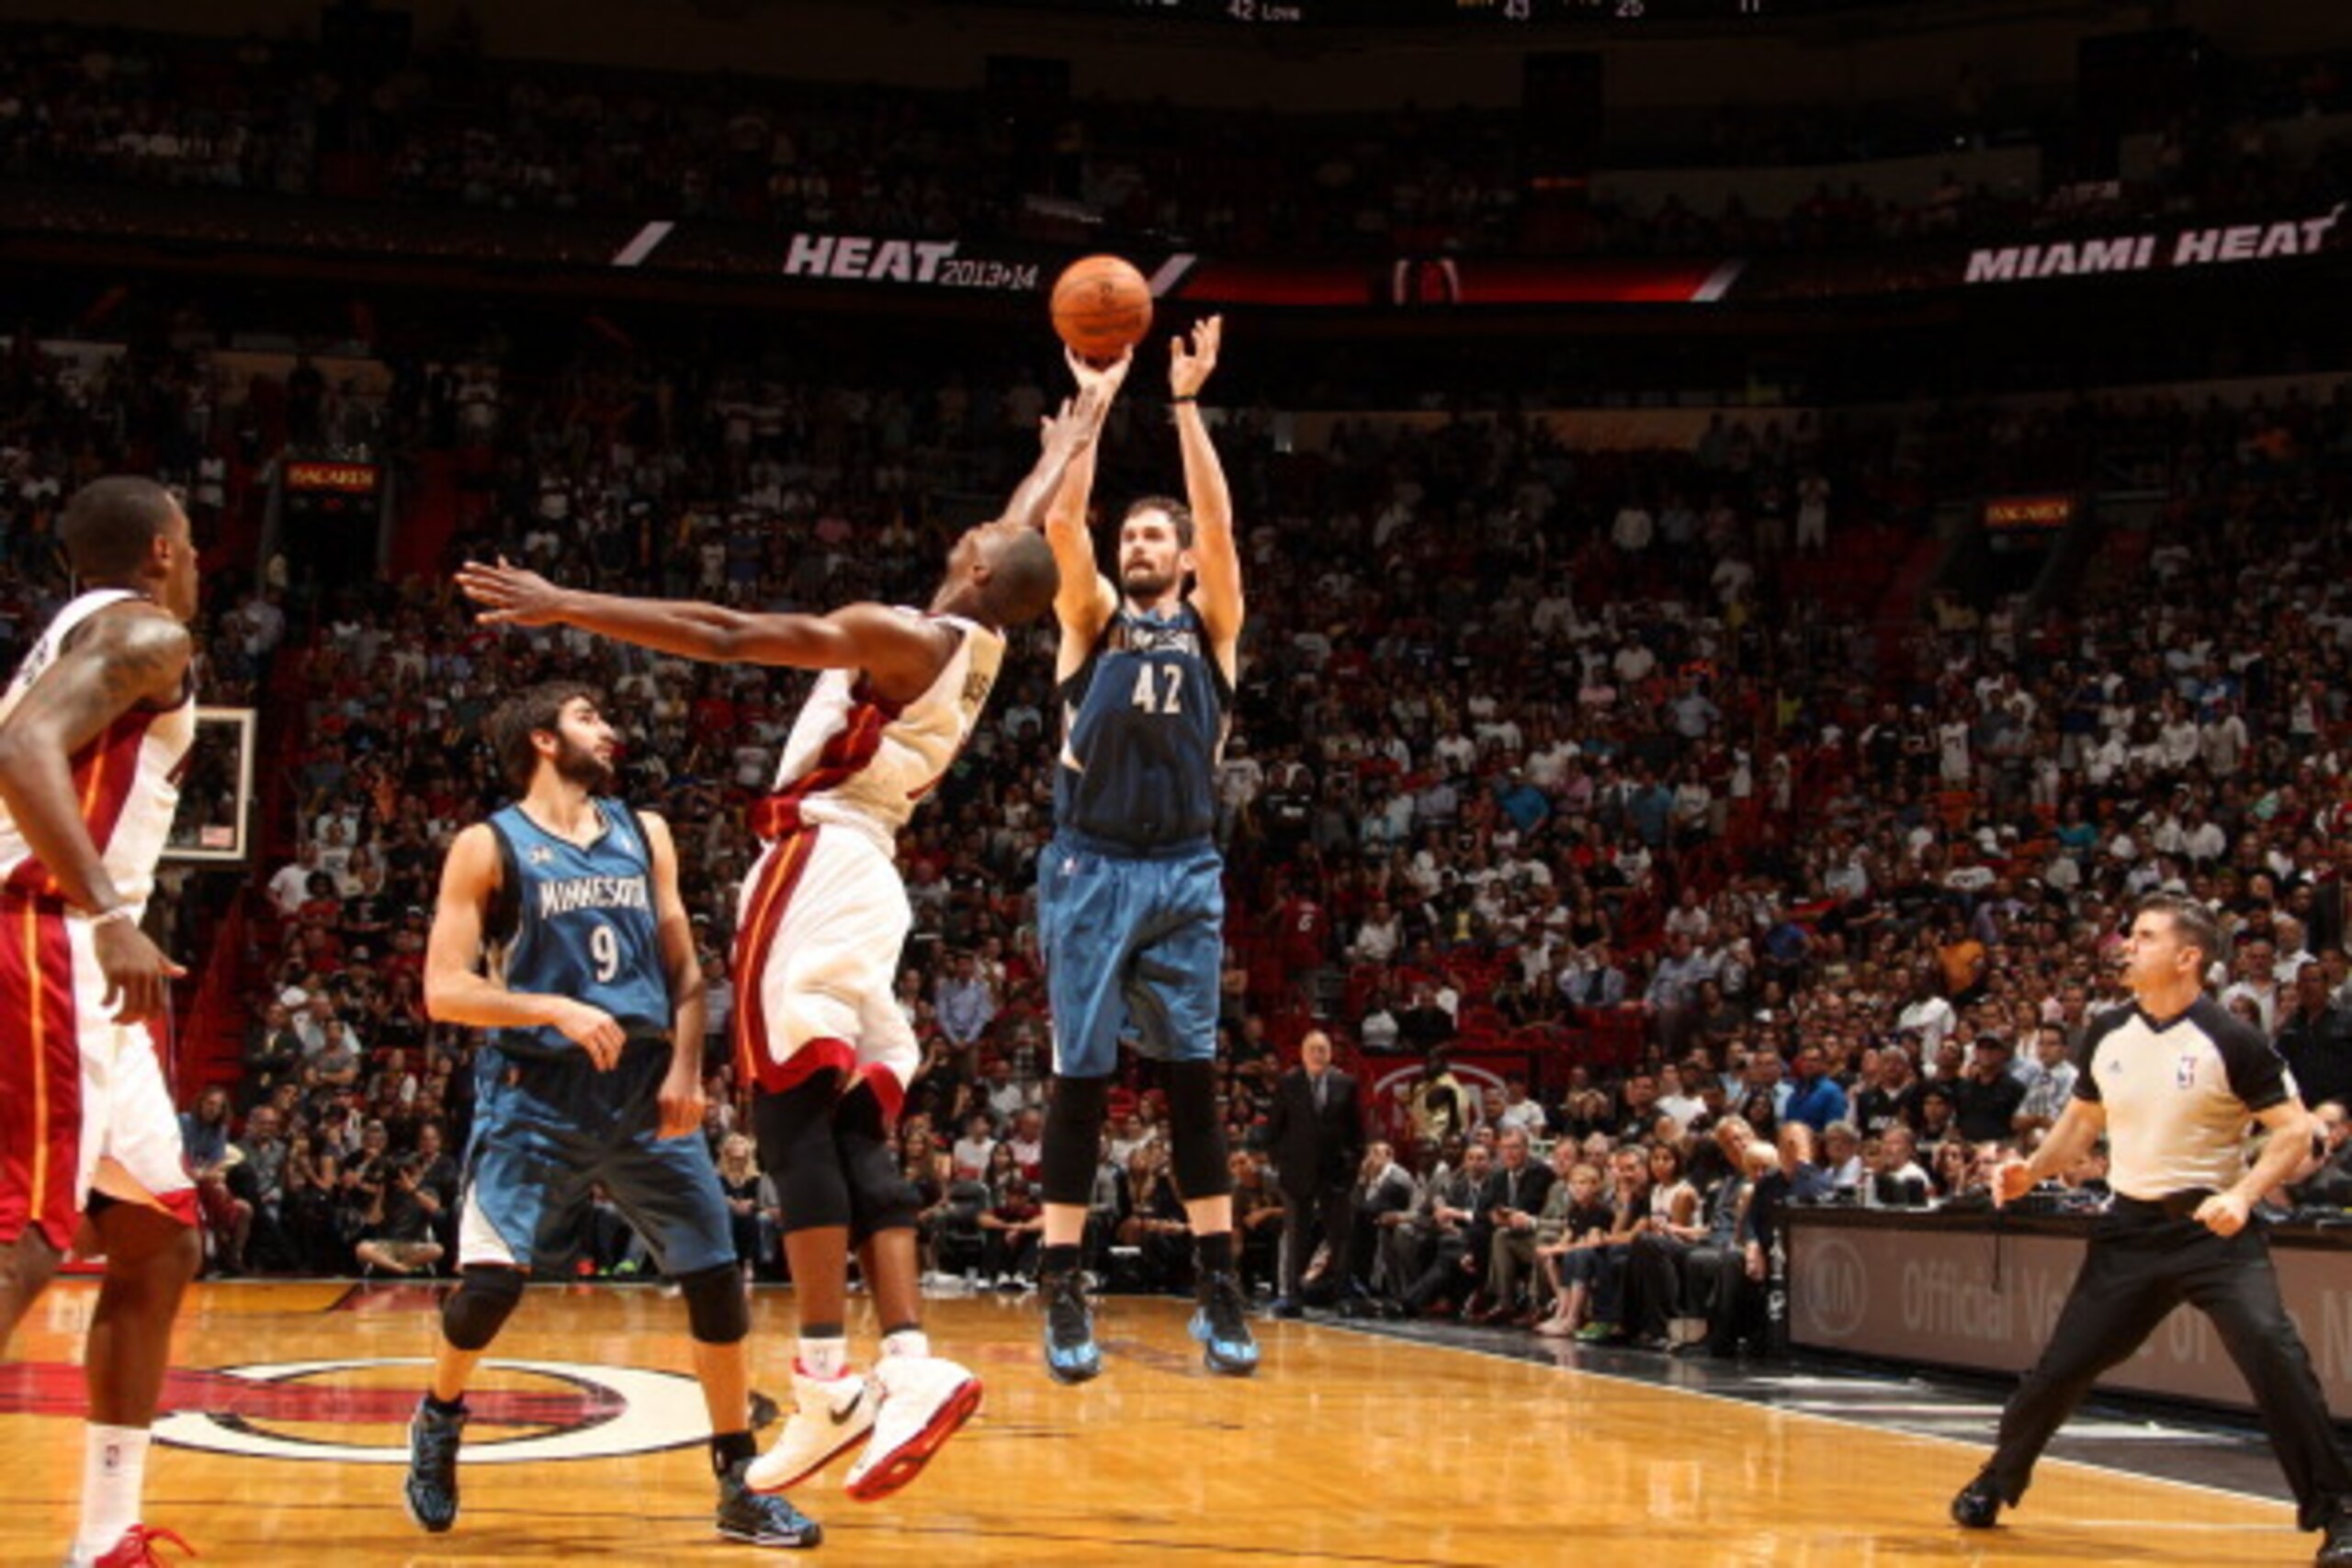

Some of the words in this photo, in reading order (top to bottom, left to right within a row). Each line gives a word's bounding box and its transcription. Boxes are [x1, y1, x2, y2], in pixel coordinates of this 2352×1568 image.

[783, 233, 960, 283] HEAT
[1964, 234, 2157, 283] MIAMI
[2172, 201, 2347, 266] HEAT
[1132, 661, 1184, 715] 42
[591, 925, 619, 983] 9
